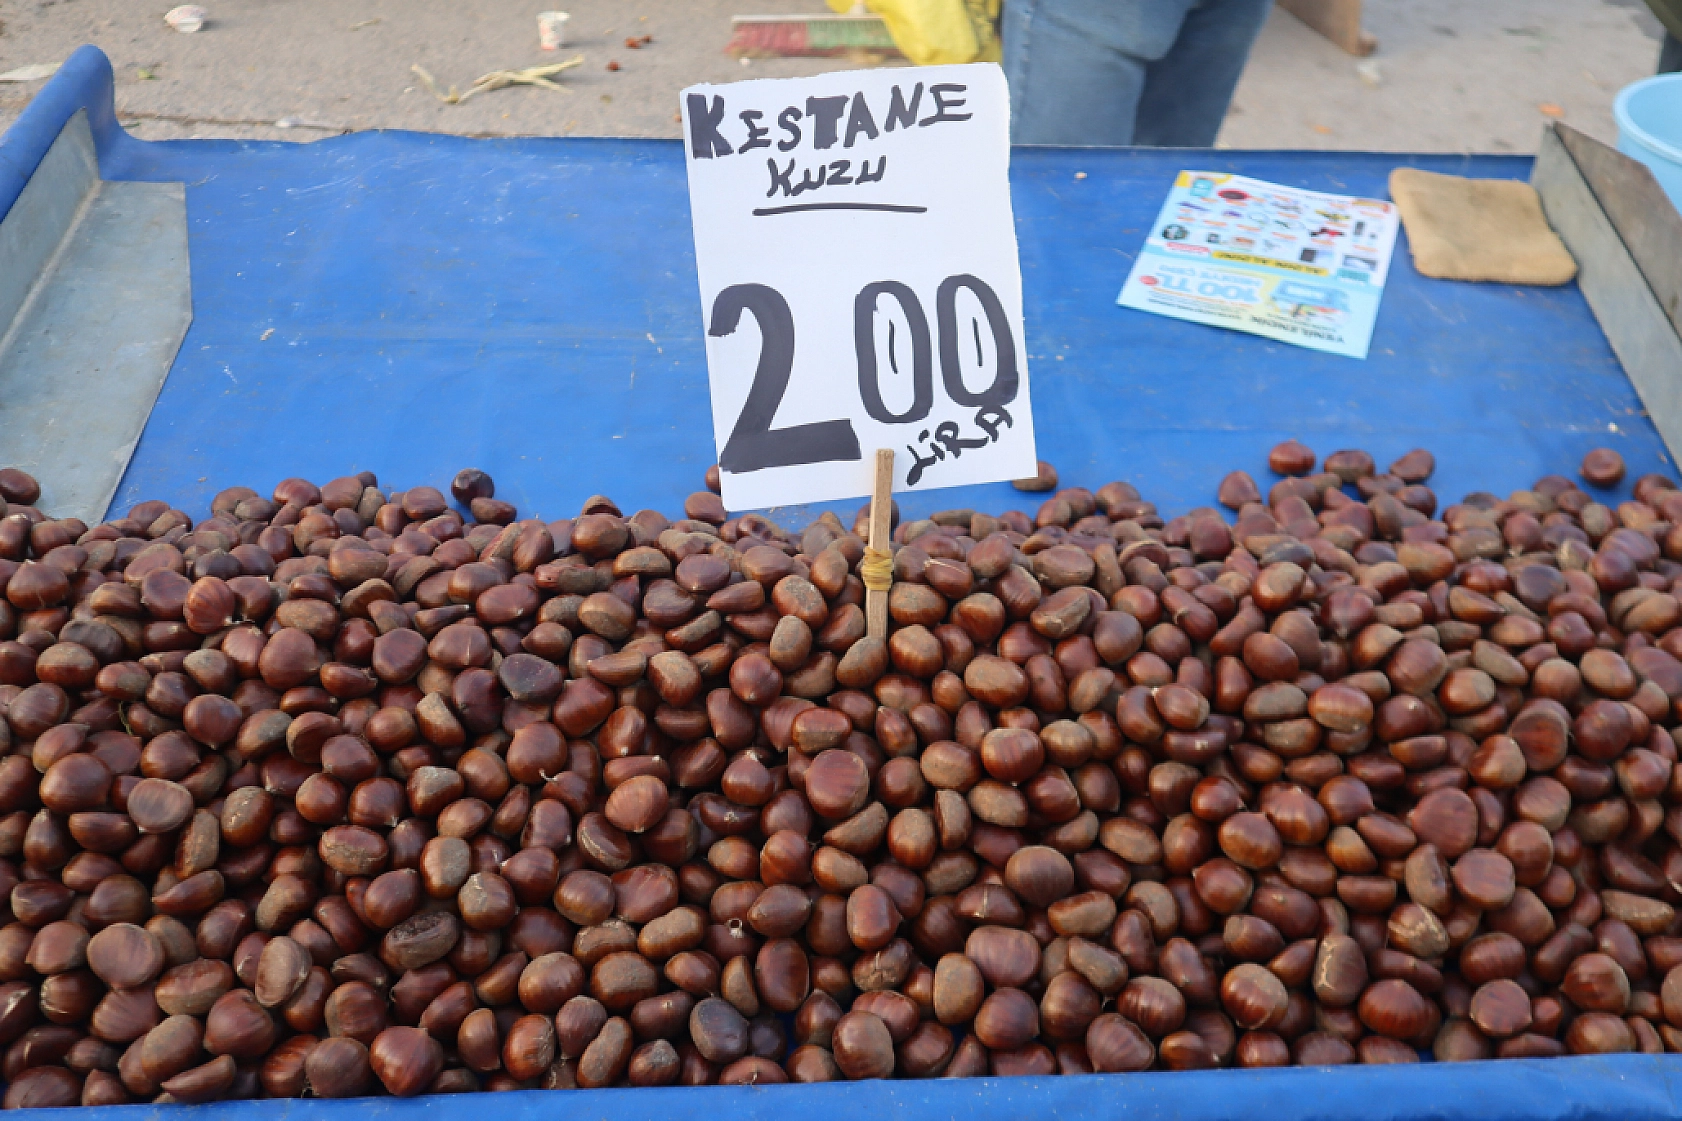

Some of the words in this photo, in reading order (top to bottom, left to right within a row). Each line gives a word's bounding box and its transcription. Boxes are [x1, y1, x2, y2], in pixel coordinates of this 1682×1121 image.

[687, 82, 973, 159] KESTANE
[1156, 273, 1192, 293] TL
[1198, 282, 1259, 302] 100
